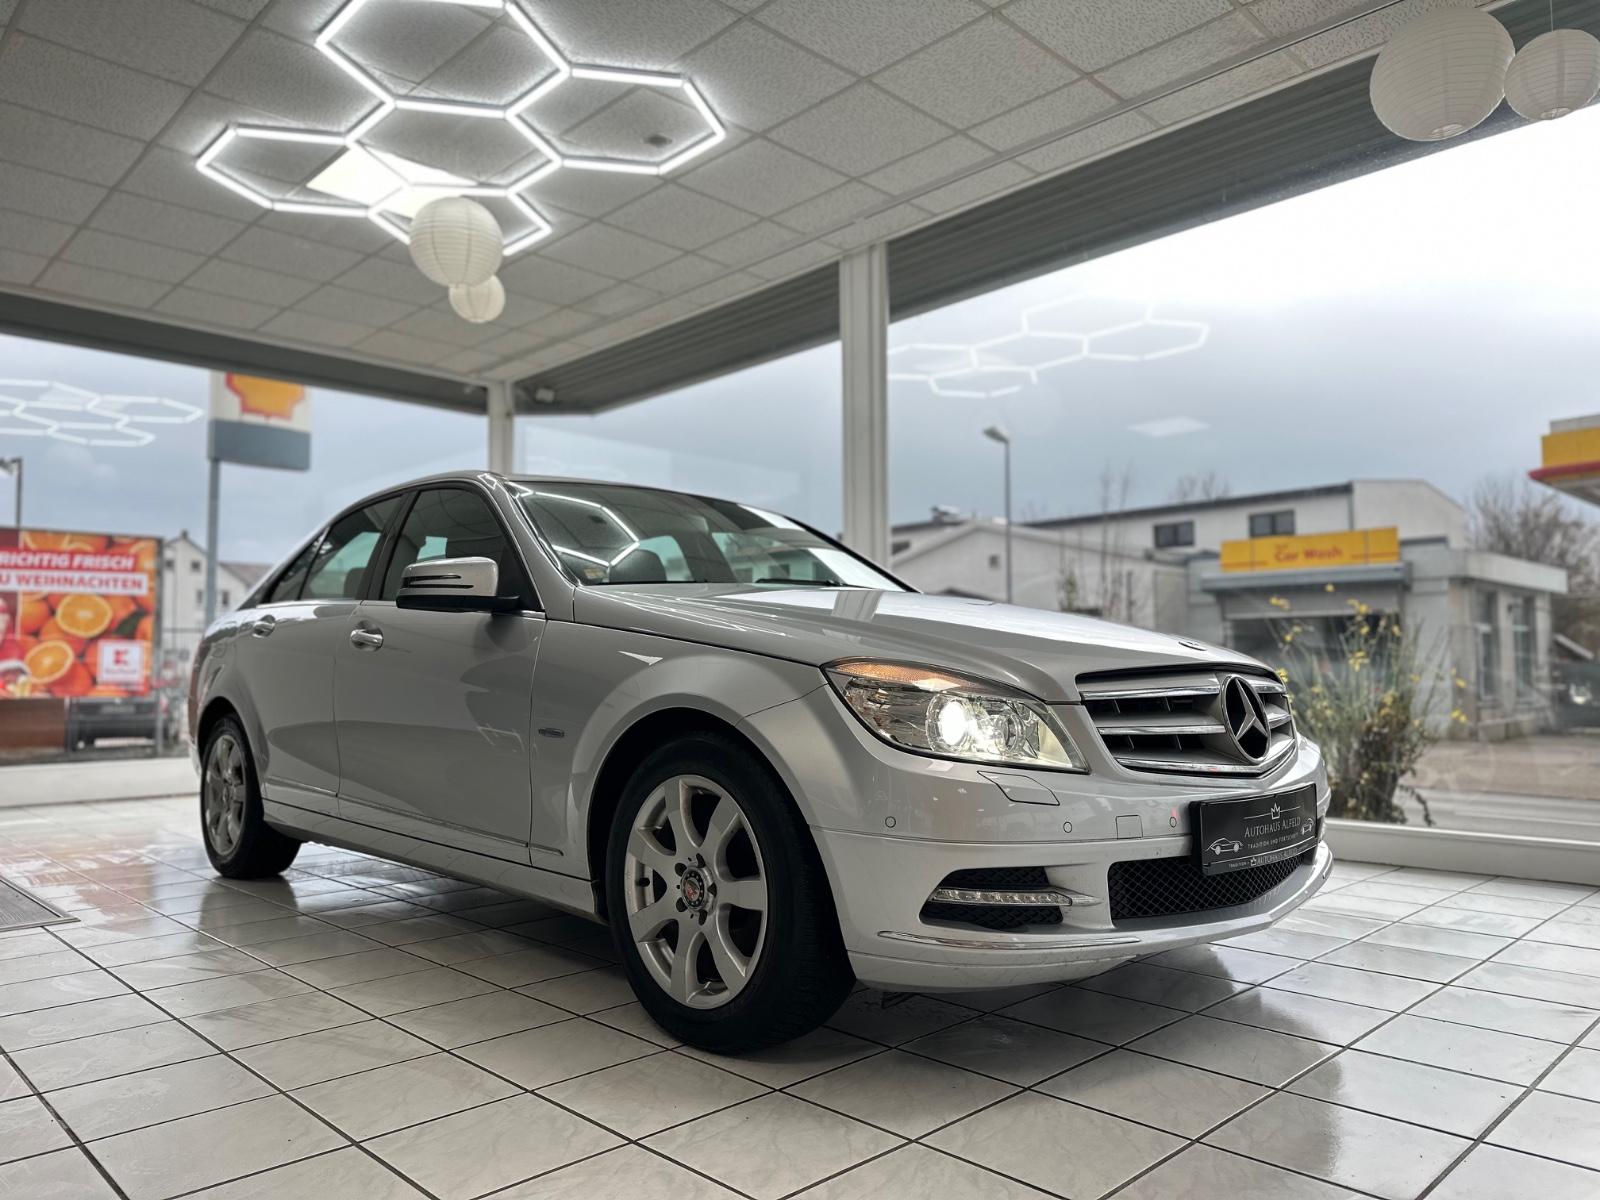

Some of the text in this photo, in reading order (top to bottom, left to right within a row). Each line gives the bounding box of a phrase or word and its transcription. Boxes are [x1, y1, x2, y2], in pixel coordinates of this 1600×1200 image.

[0, 552, 135, 570] RICHTIG FRISCH
[1304, 545, 1343, 561] Wash
[16, 574, 143, 589] WEIHNACHTEN
[1244, 816, 1301, 838] AUTOHAUS ALFELD
[1247, 840, 1269, 849] TRADITION
